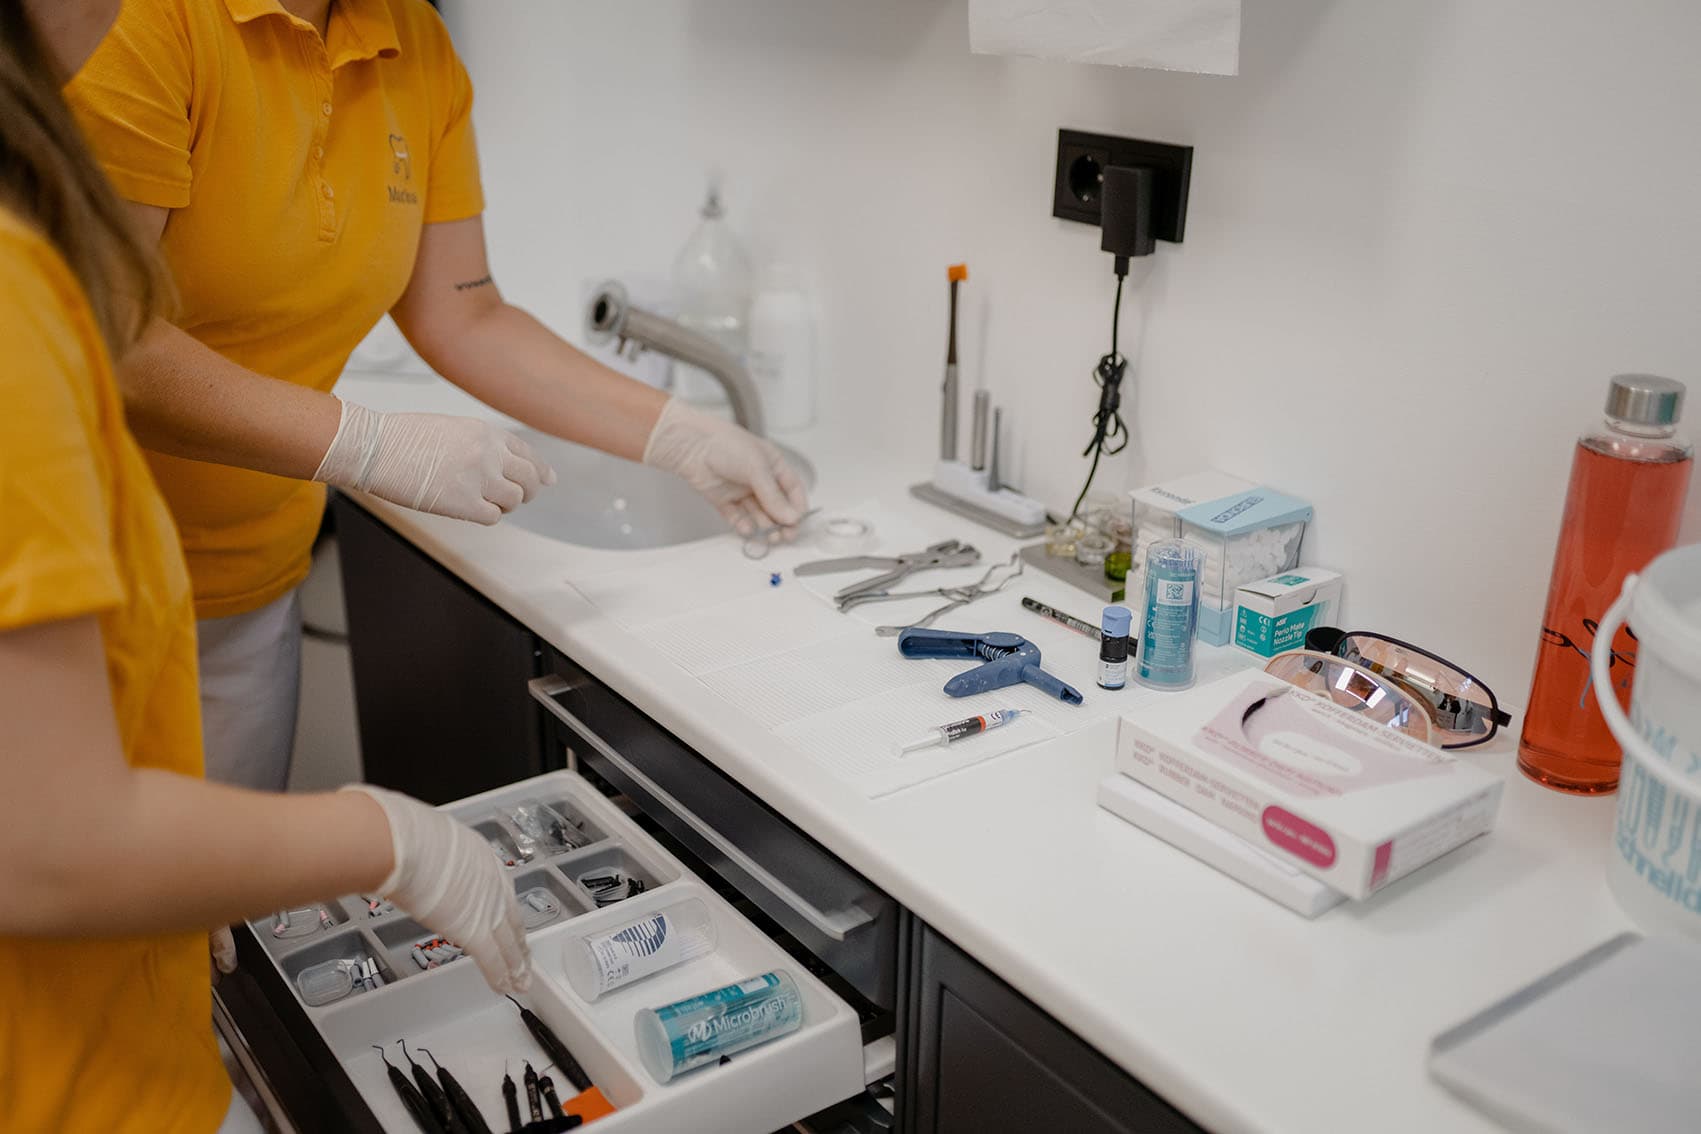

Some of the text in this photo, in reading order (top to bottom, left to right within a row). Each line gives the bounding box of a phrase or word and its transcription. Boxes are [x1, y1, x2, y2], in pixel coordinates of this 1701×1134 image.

[1273, 630, 1303, 646] Nozzle Tip
[1274, 622, 1305, 638] Perio Mate
[714, 996, 787, 1035] Microbrush
